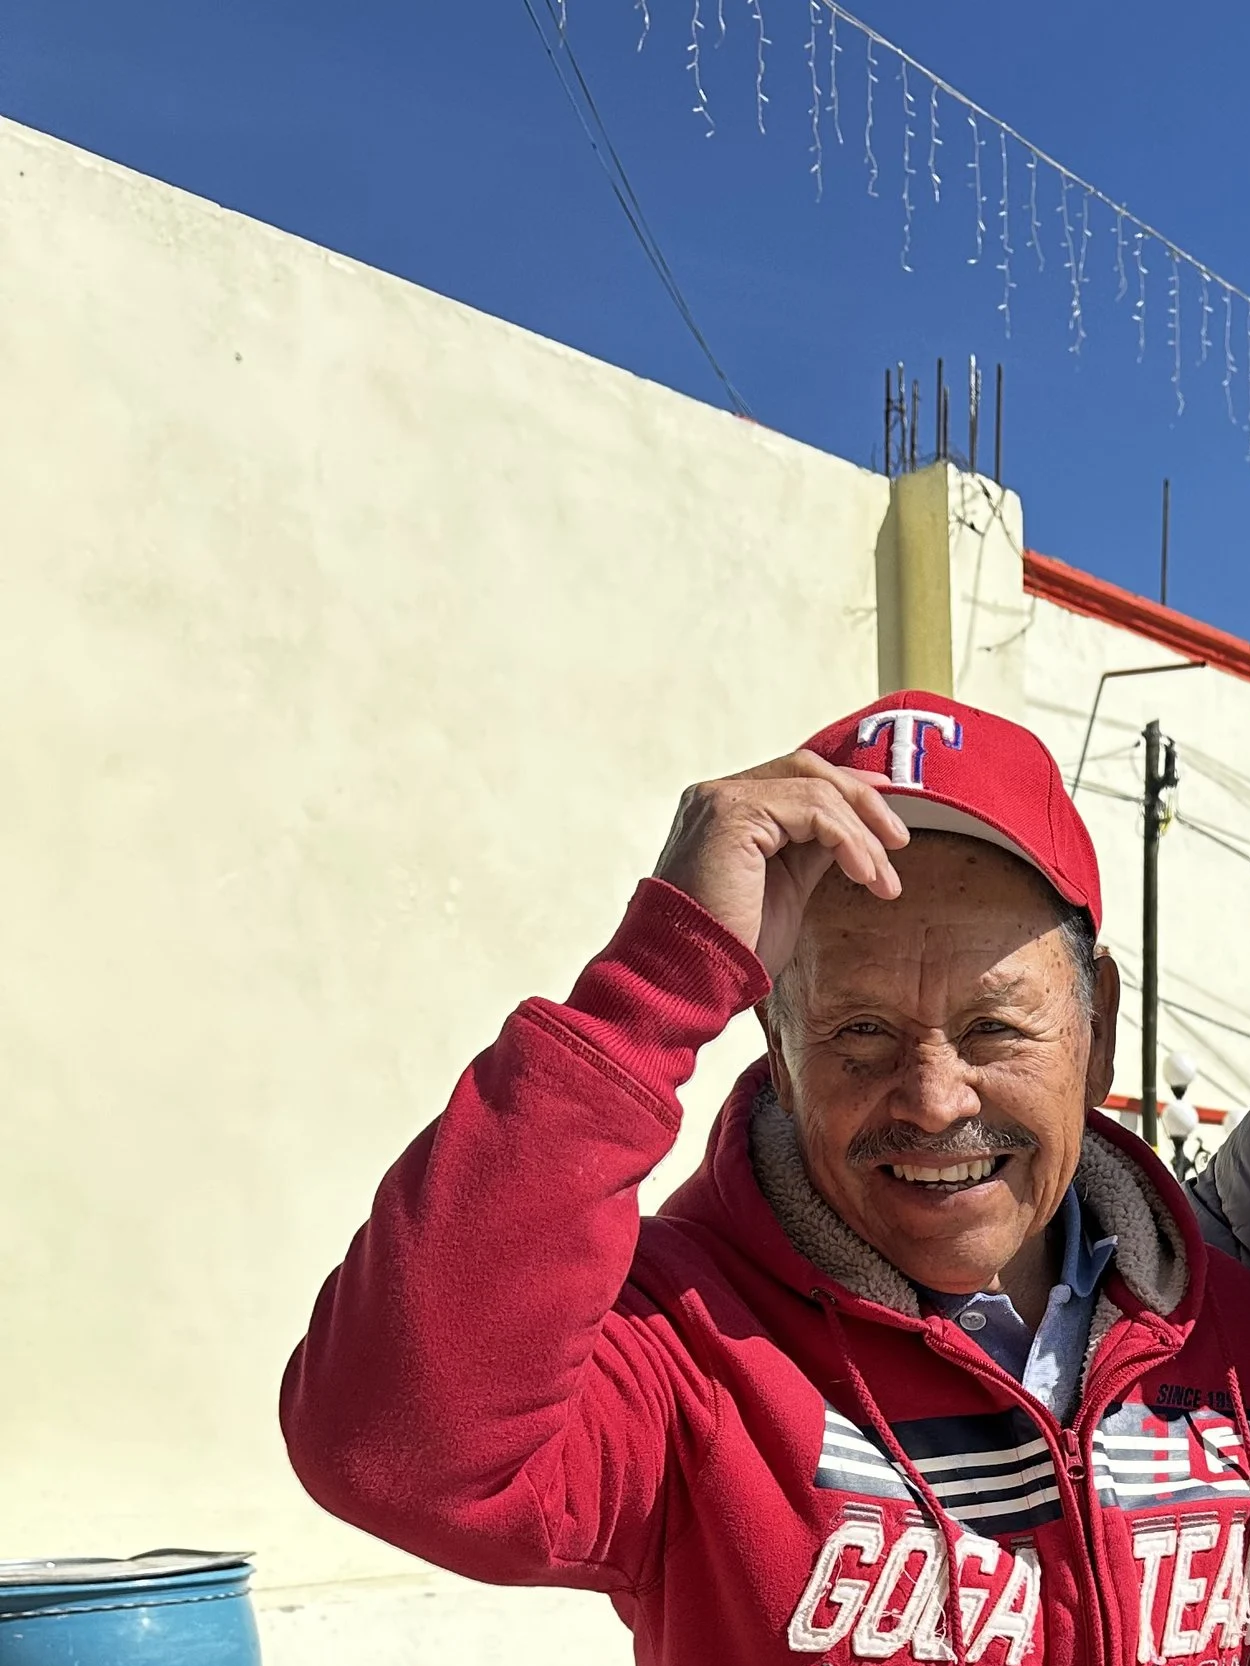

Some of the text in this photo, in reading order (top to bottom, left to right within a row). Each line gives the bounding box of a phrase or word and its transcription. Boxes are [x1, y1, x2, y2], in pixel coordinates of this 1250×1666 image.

[856, 708, 963, 789] T
[1156, 1383, 1202, 1408] SINCE
[788, 1514, 1042, 1666] GOGA
